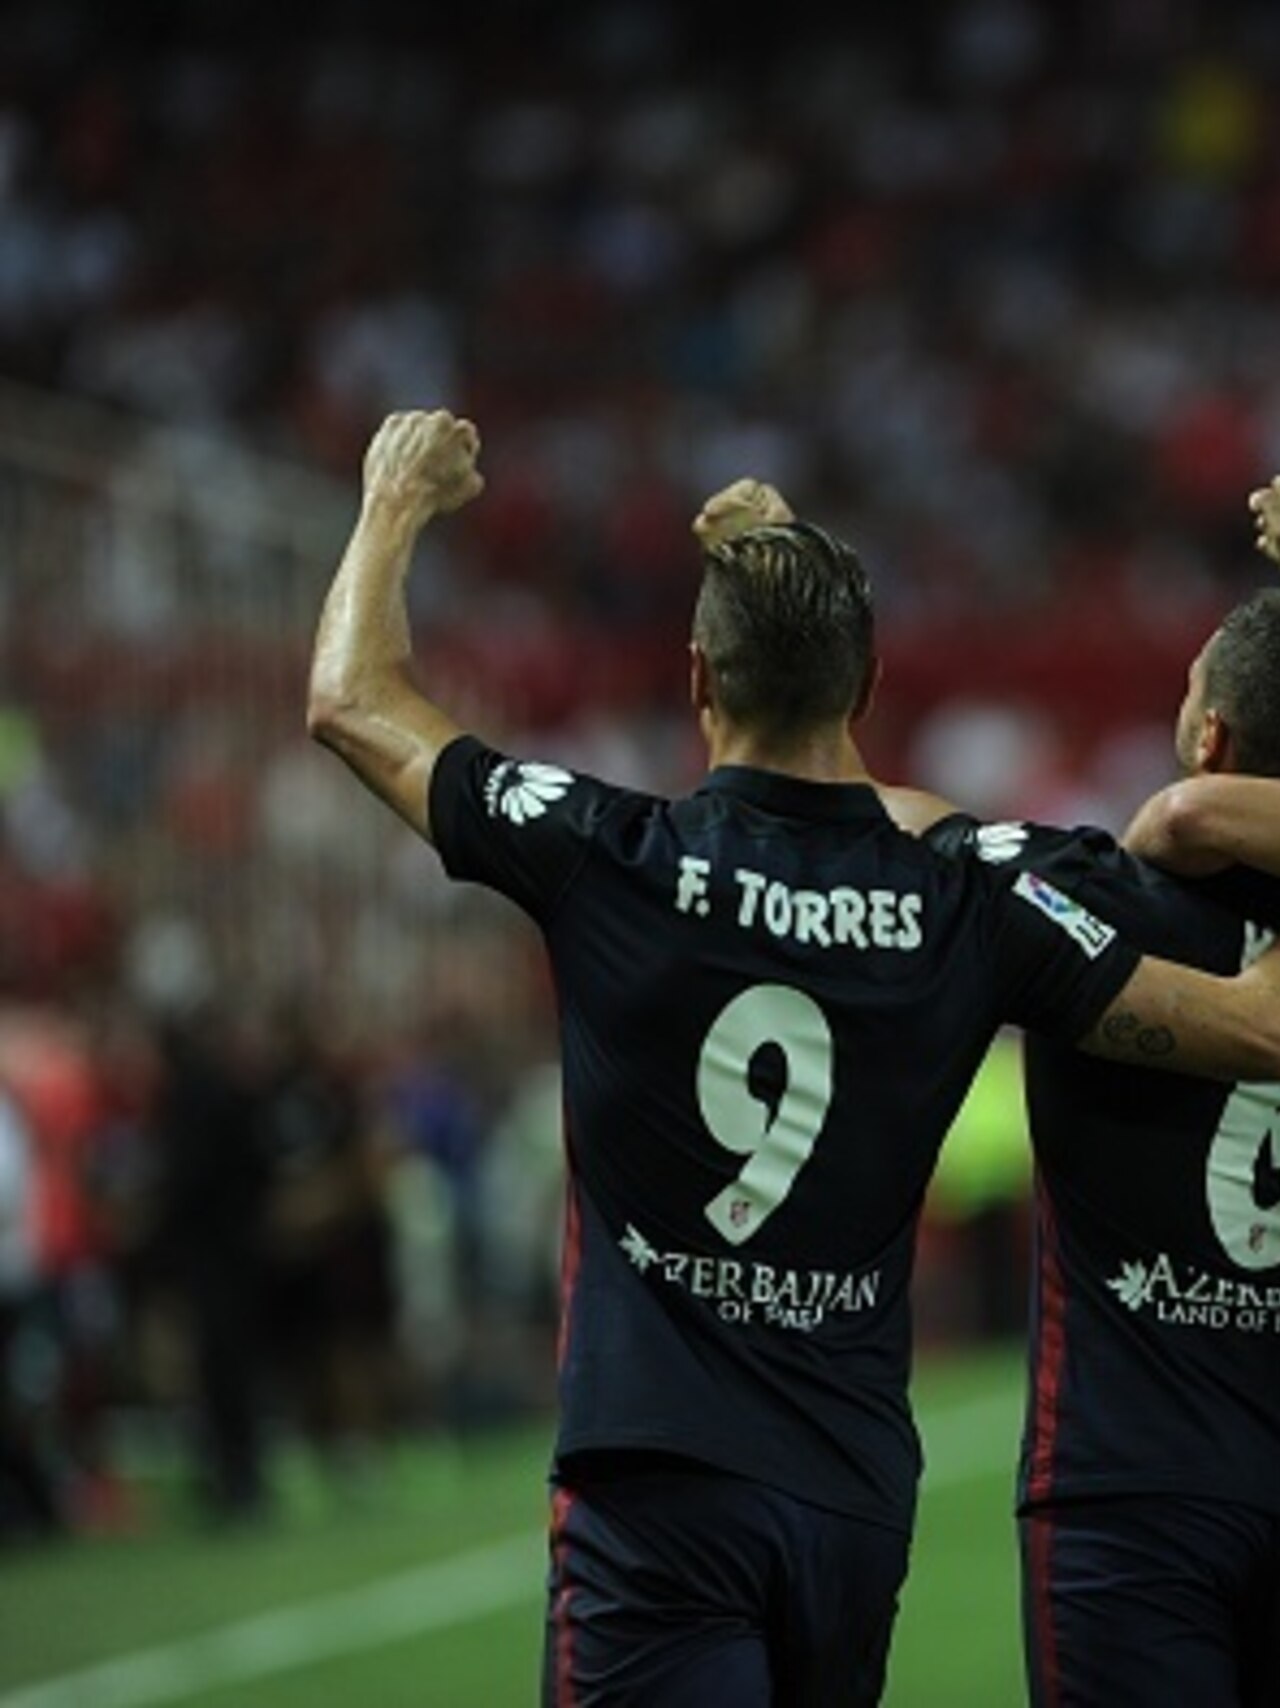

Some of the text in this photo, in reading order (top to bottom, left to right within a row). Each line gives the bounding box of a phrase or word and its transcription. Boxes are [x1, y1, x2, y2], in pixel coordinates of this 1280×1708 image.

[677, 857, 923, 950] F. TORRES
[695, 983, 833, 1245] 9
[652, 1249, 881, 1311] ZERBAIJAN
[1156, 1300, 1220, 1330] LAND
